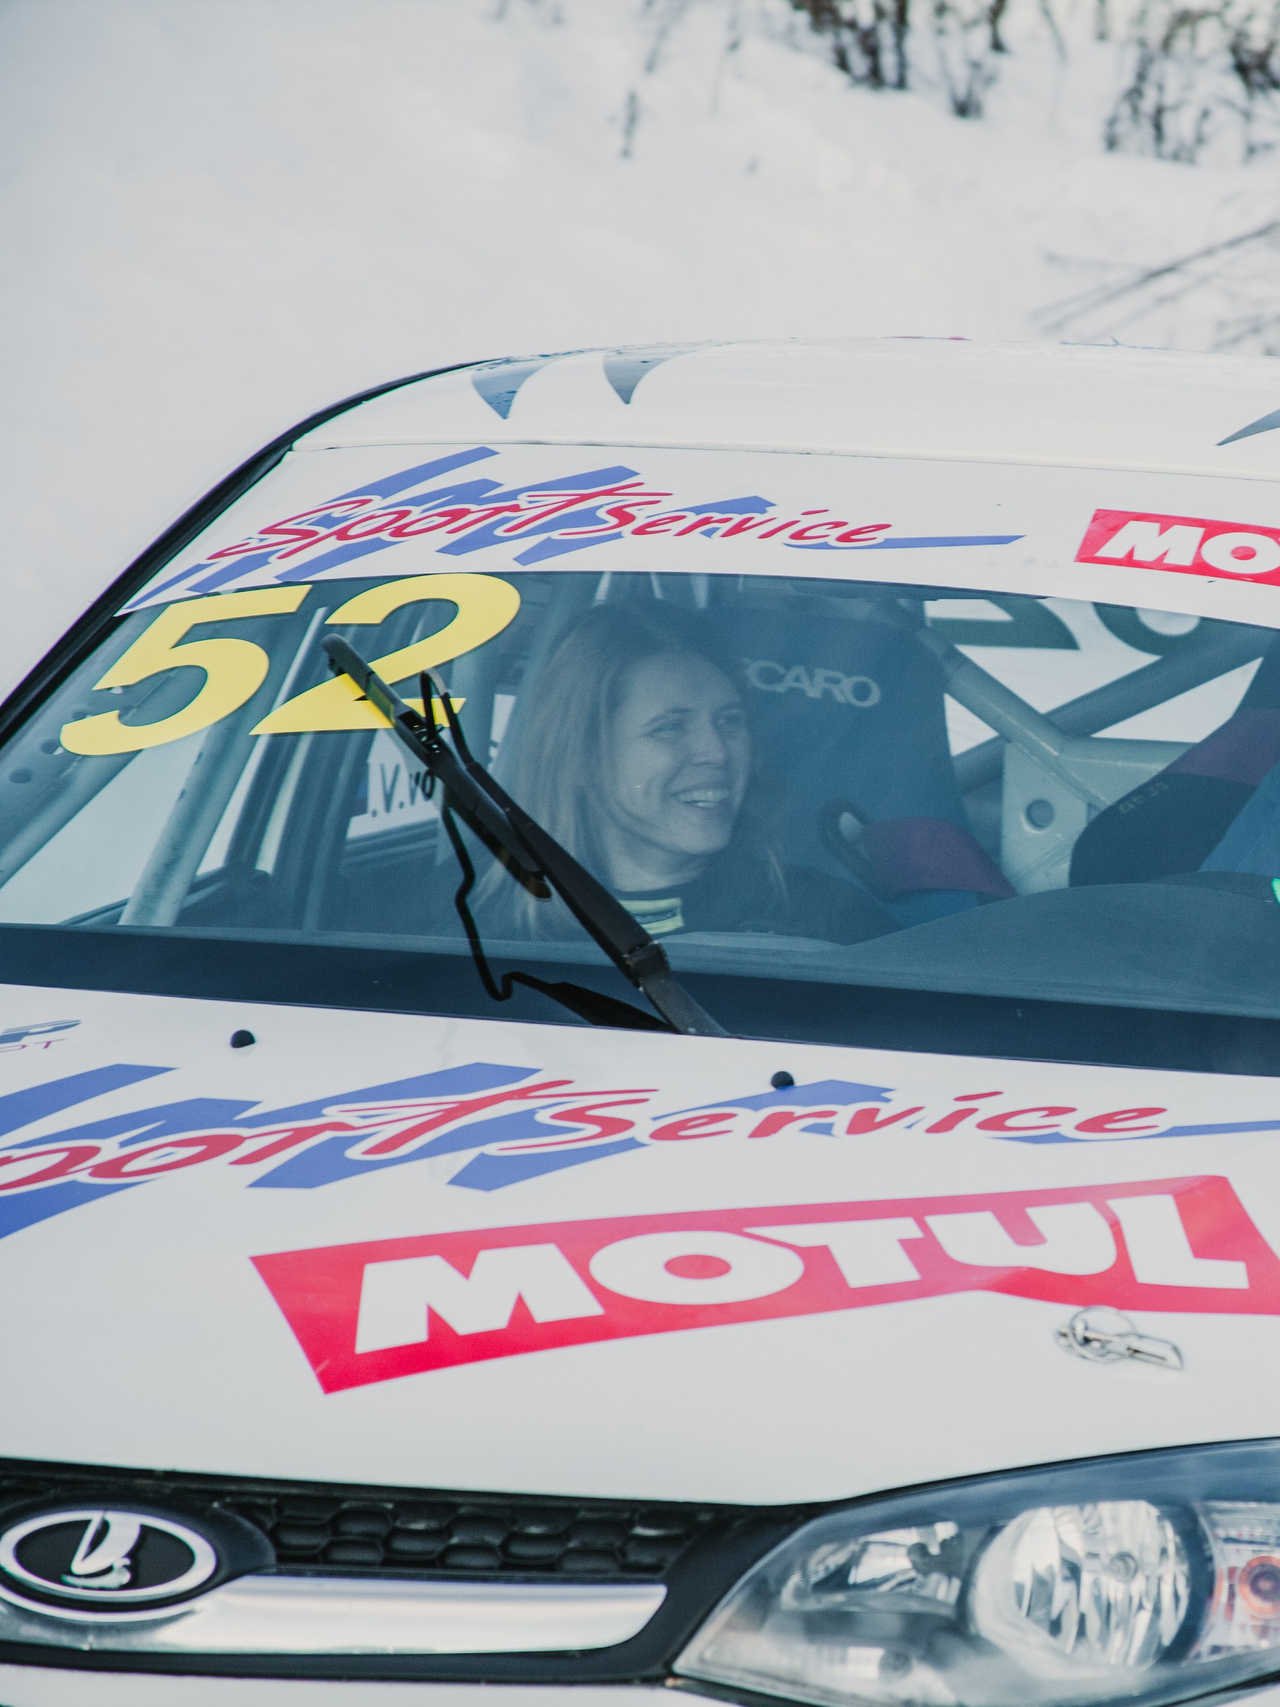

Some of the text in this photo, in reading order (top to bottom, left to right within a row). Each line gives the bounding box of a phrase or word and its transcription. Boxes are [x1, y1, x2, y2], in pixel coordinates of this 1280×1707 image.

[207, 482, 672, 559] Sport
[60, 572, 521, 756] 52
[741, 657, 881, 707] CARO
[355, 1193, 1250, 1355] MOTUL
